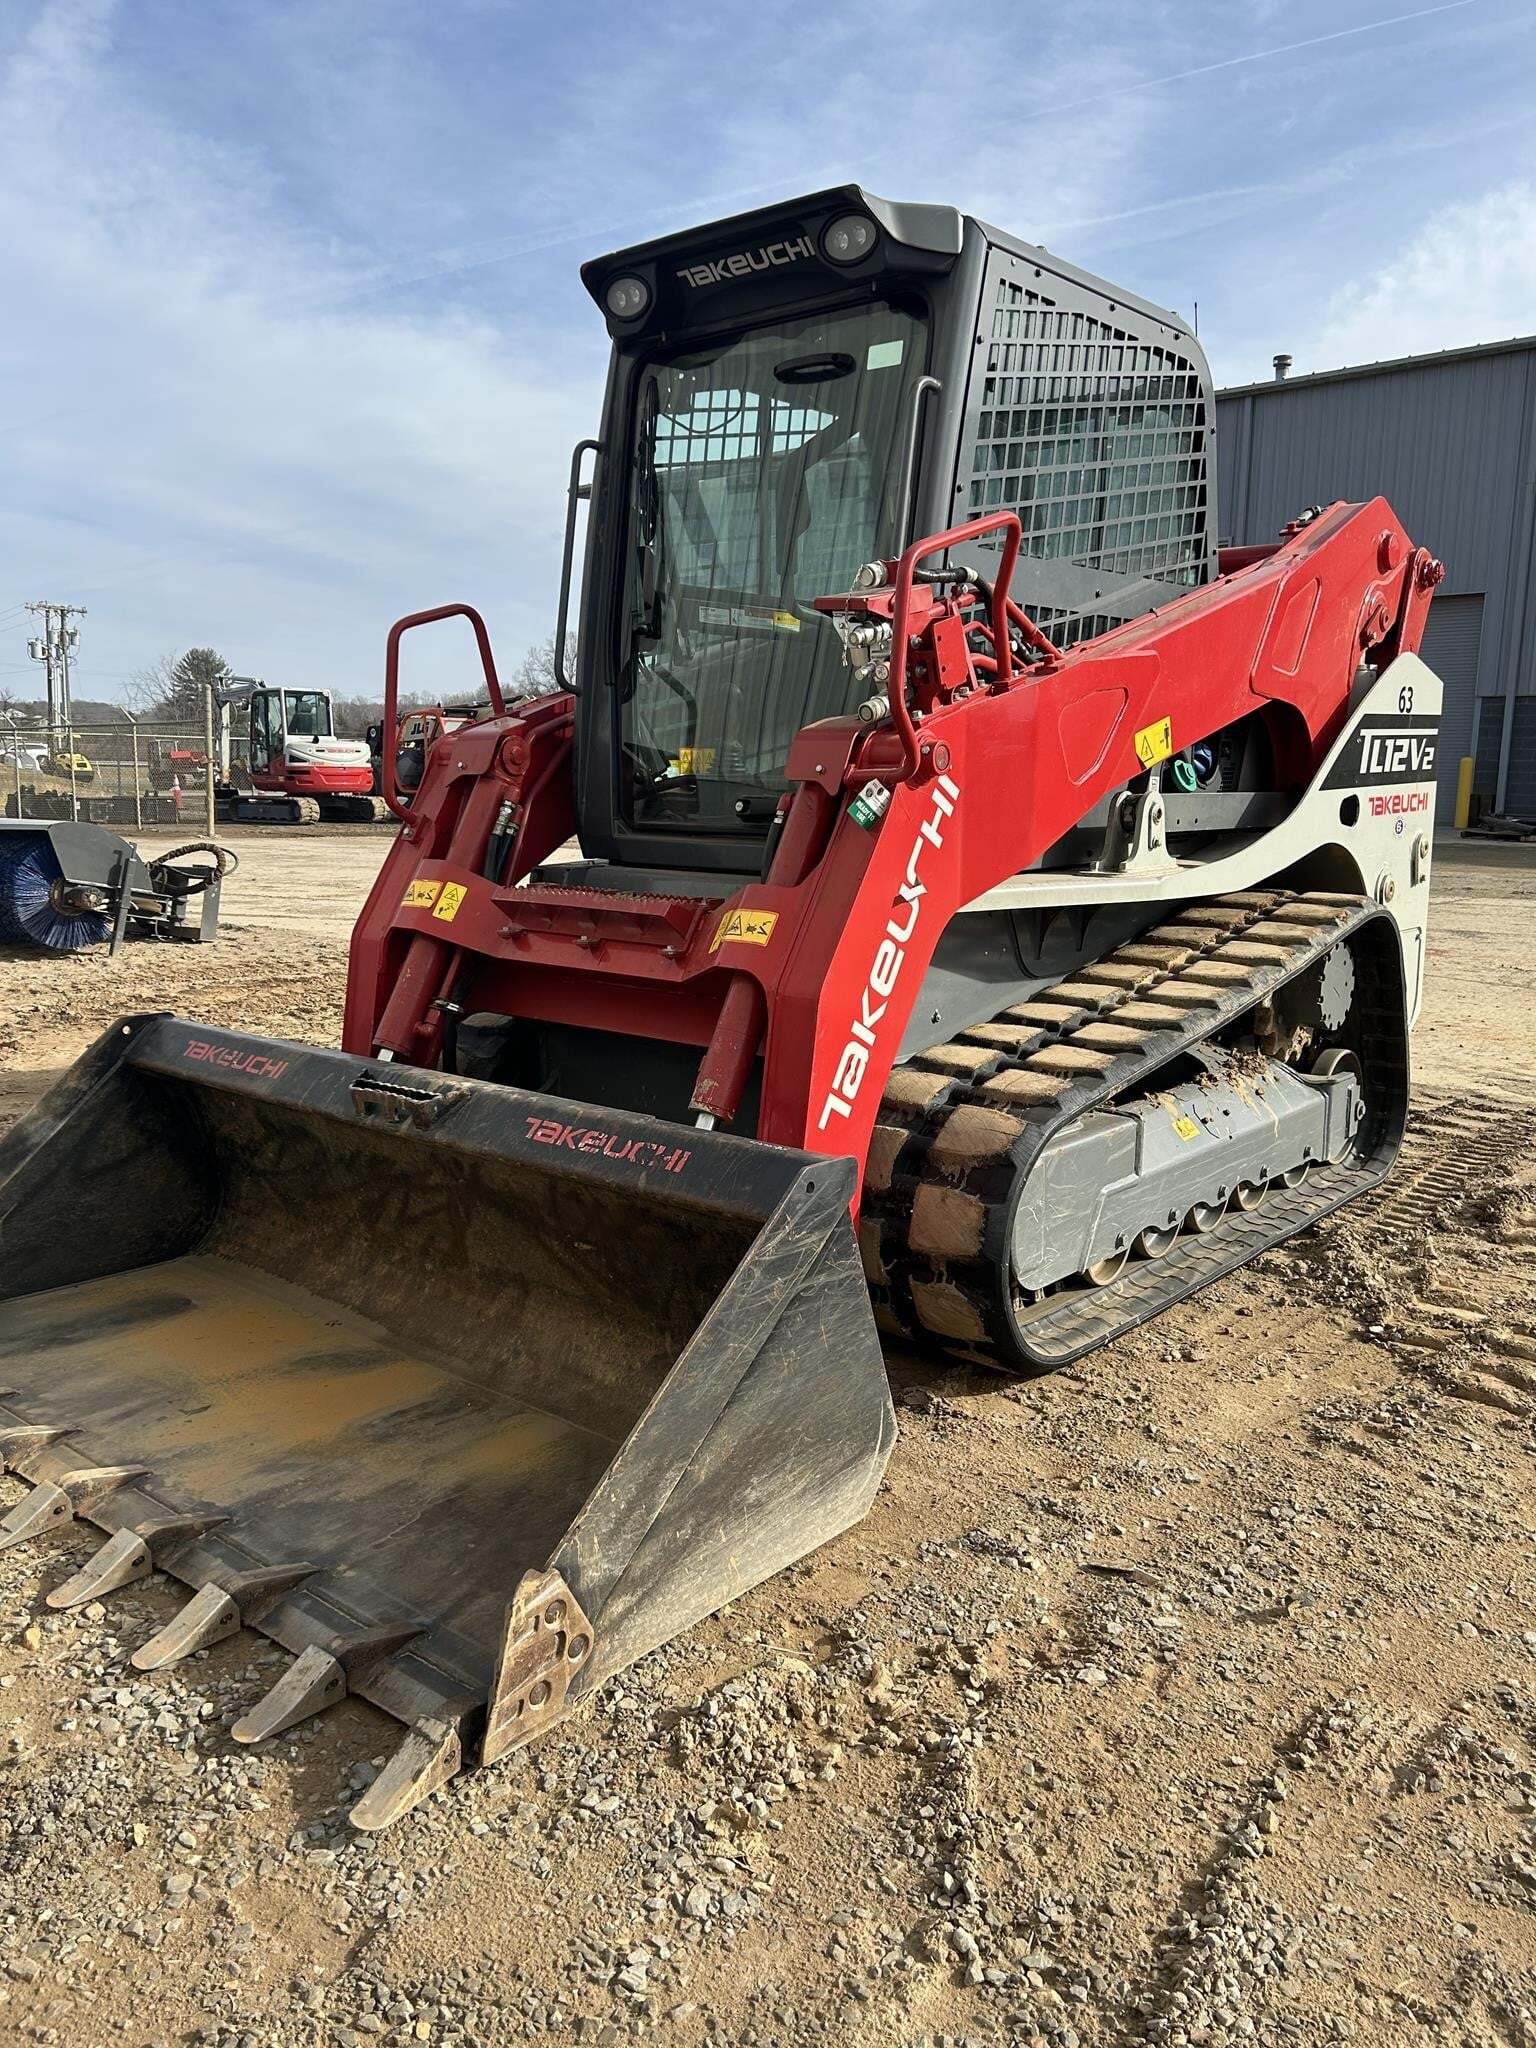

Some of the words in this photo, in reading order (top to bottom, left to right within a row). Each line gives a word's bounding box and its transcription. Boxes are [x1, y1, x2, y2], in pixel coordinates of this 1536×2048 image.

[677, 236, 816, 288] TAKEUCHI
[1398, 686, 1414, 714] 63
[1368, 792, 1429, 817] TAKEUCHI
